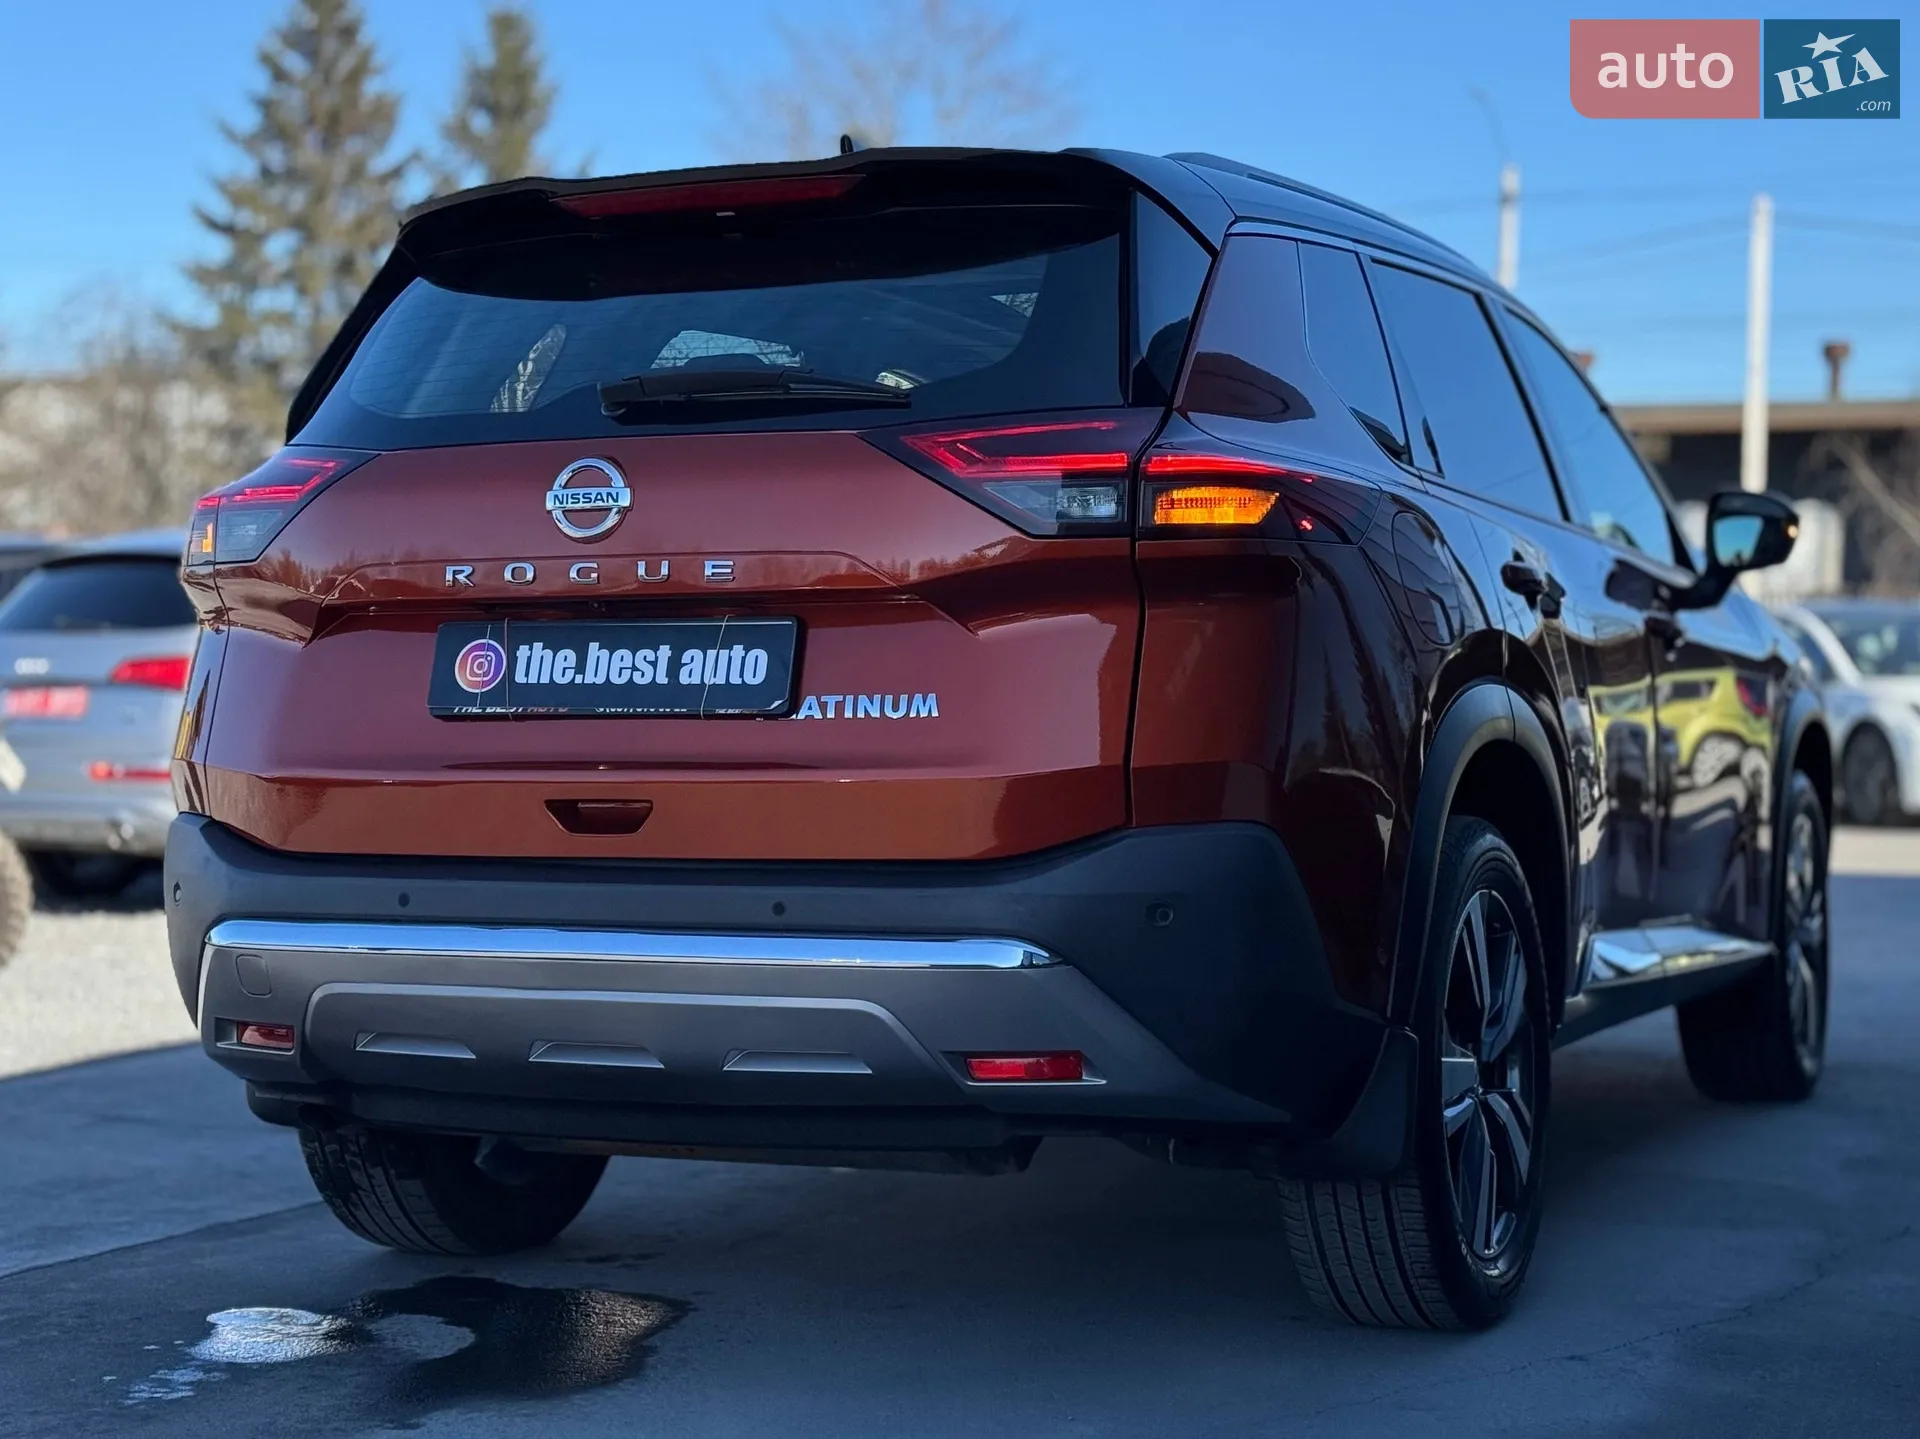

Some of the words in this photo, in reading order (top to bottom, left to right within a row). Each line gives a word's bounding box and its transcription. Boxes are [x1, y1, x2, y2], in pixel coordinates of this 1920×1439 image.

[552, 491, 620, 506] NISSAN
[444, 559, 736, 588] ROGUE
[514, 641, 672, 685] the.best
[678, 644, 769, 686] auto
[788, 692, 940, 720] ATINUM
